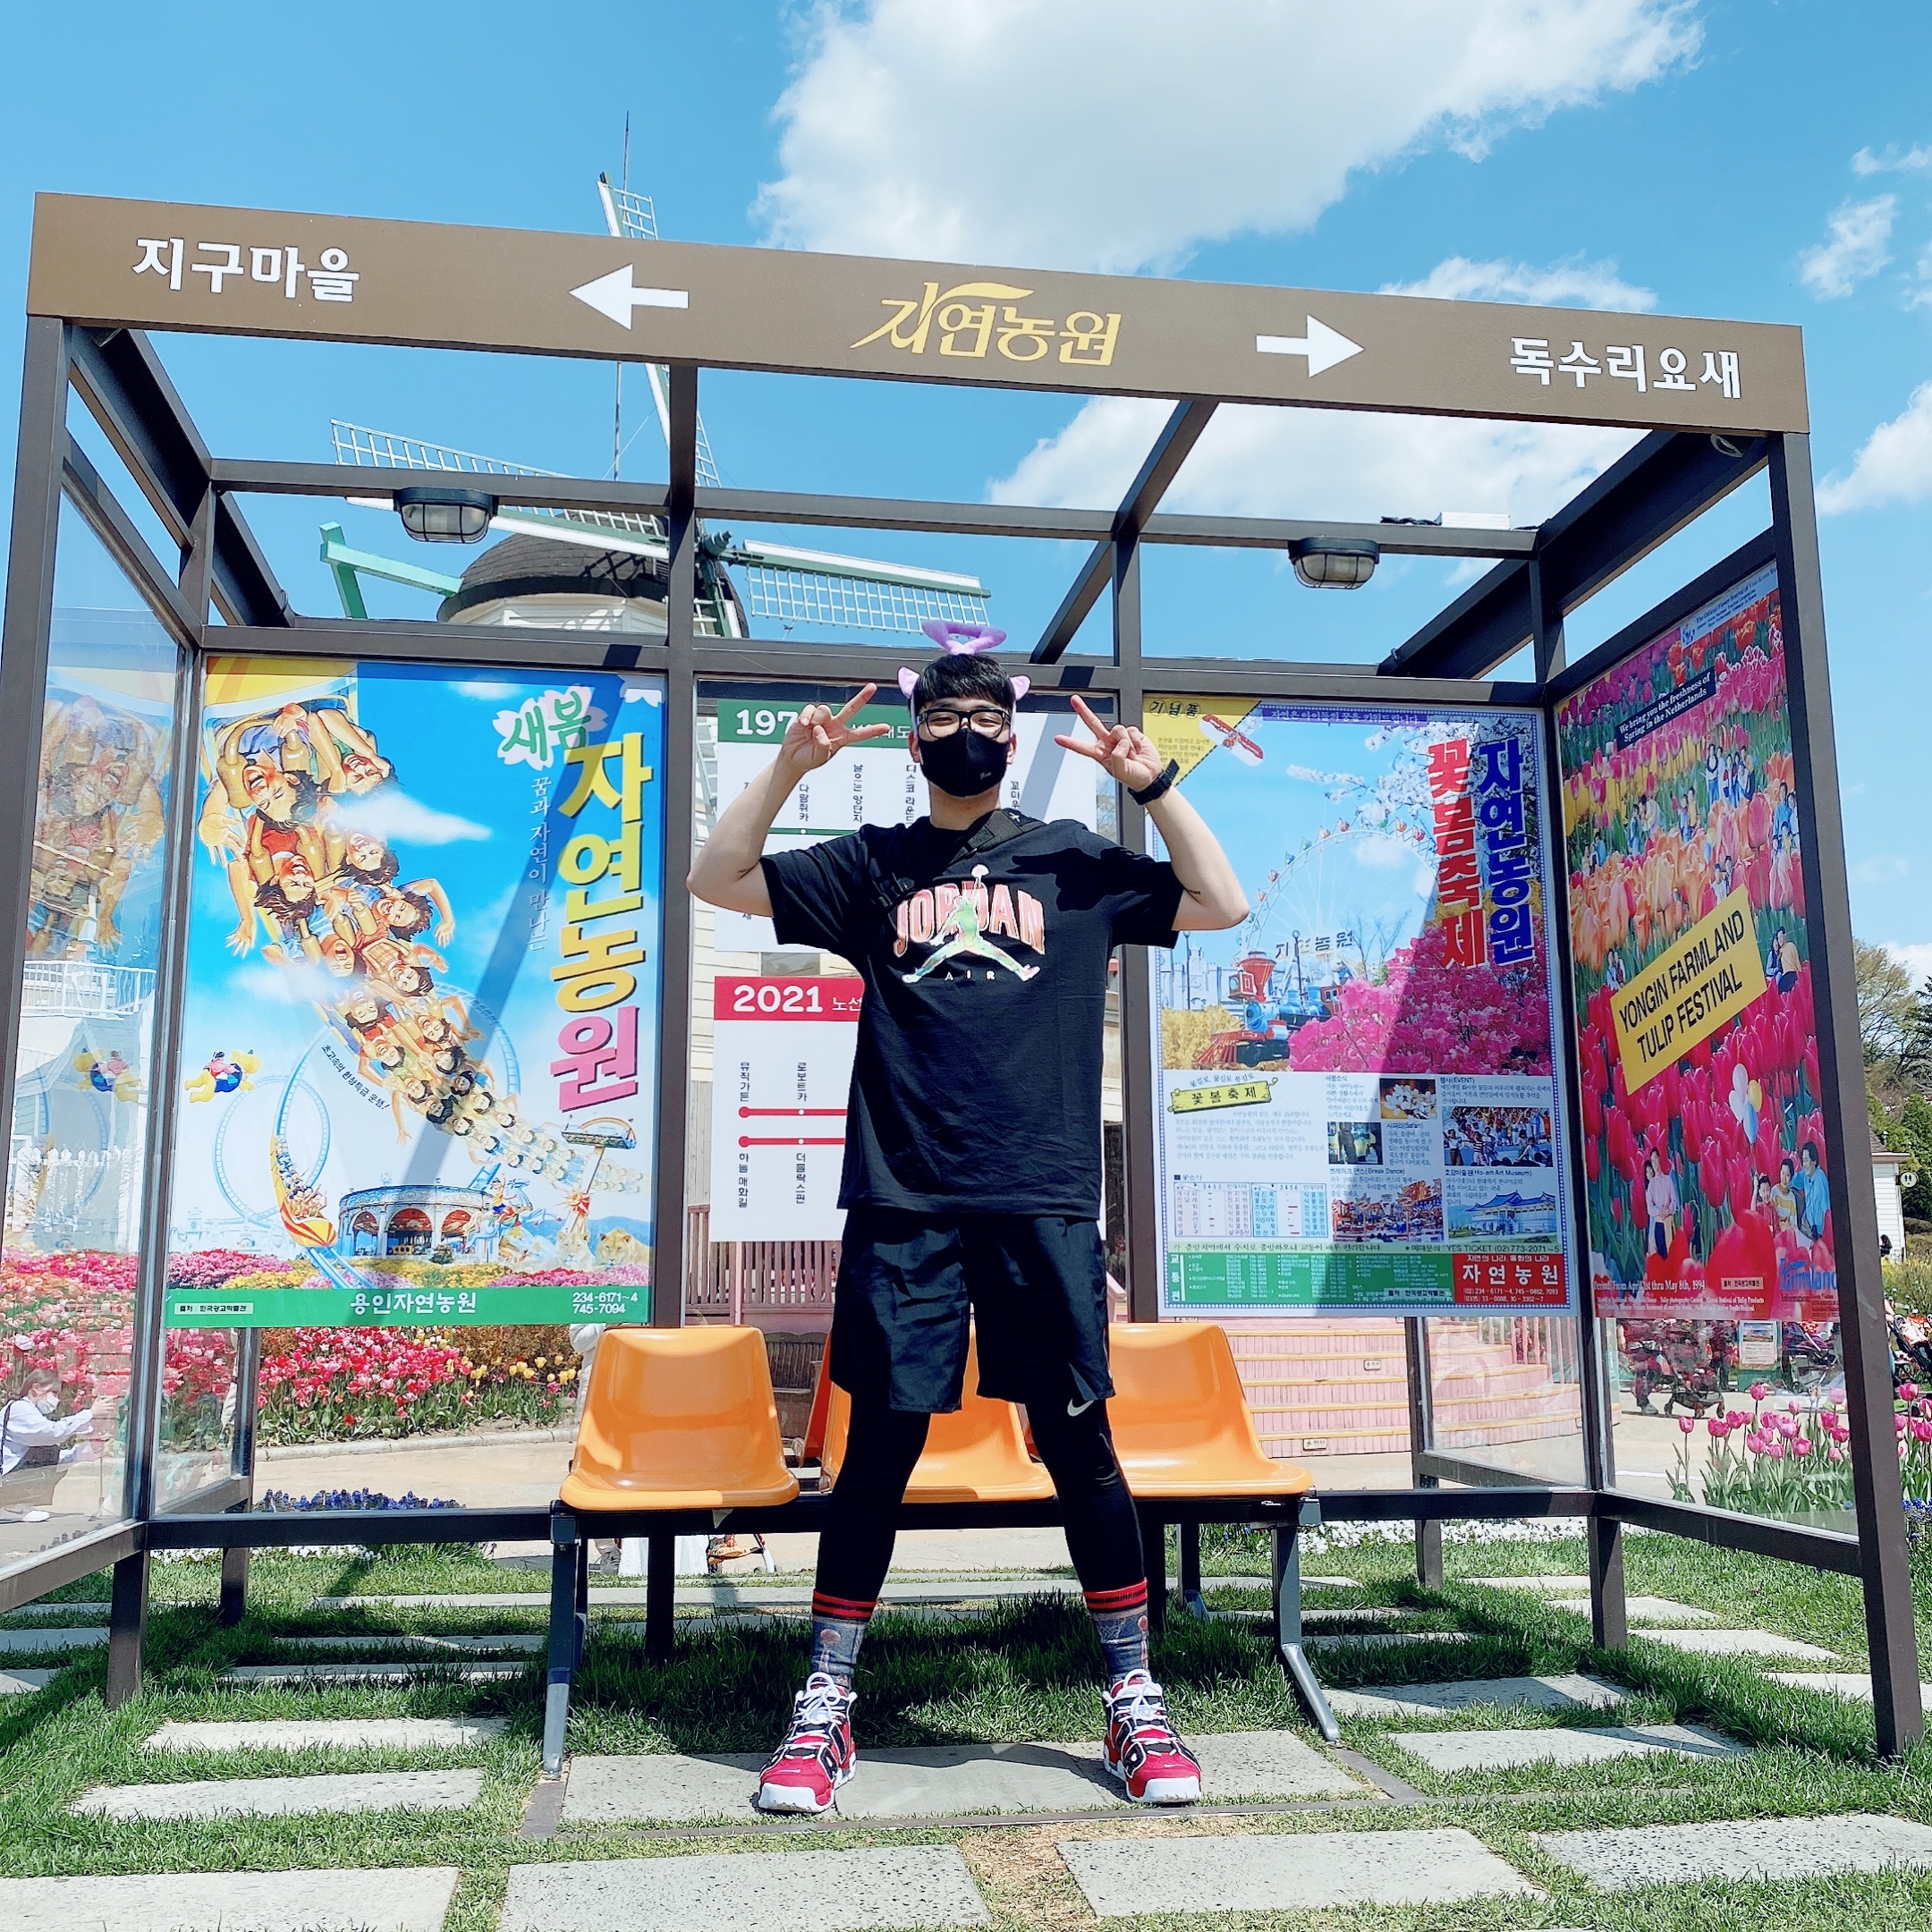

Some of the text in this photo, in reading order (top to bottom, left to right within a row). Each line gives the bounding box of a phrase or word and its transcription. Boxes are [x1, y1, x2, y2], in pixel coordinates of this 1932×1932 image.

[131, 238, 360, 301] 지구마을
[850, 280, 1122, 367] 자연농원
[1510, 337, 1741, 400] 독수리요새
[502, 691, 592, 761] 새봄
[736, 709, 799, 736] 197
[1150, 700, 1200, 718] 기념품
[1619, 672, 1710, 734] We bring you the freshness of
[1624, 688, 1707, 743] Spring in the Netherlands
[799, 784, 809, 821] 다람쥐카
[905, 765, 917, 793] 디스코
[526, 776, 553, 952] 꿈과 자연이 만나는
[1427, 738, 1487, 970] 꽃봄축제
[1479, 737, 1536, 968] 자연농원
[550, 732, 654, 1112] 자연농원
[894, 880, 1045, 958] JORDAN
[1619, 910, 1744, 1033] YONGIN FARMLAND
[733, 984, 861, 1013] 2021 노선
[1637, 962, 1743, 1063] TULIP FESTIVAL
[321, 1045, 346, 1073] 초고속의
[741, 1062, 750, 1102] 뮤직가든
[797, 1062, 807, 1102] 로보트카
[738, 1153, 750, 1208] 하늘 매화길
[796, 1152, 807, 1204] 더블락스핀
[1445, 1244, 1462, 1252] YES
[1465, 1244, 1493, 1252] TICKET
[572, 1292, 639, 1303] 234-6171~4
[1462, 1264, 1558, 1285] 자연농원
[1628, 1280, 1644, 1293] April
[1651, 1280, 1664, 1290] thru
[1665, 1279, 1679, 1293] May
[1692, 1279, 1706, 1290] 1994
[350, 1292, 477, 1316] 용인자연농원
[572, 1302, 626, 1315] 745-7094
